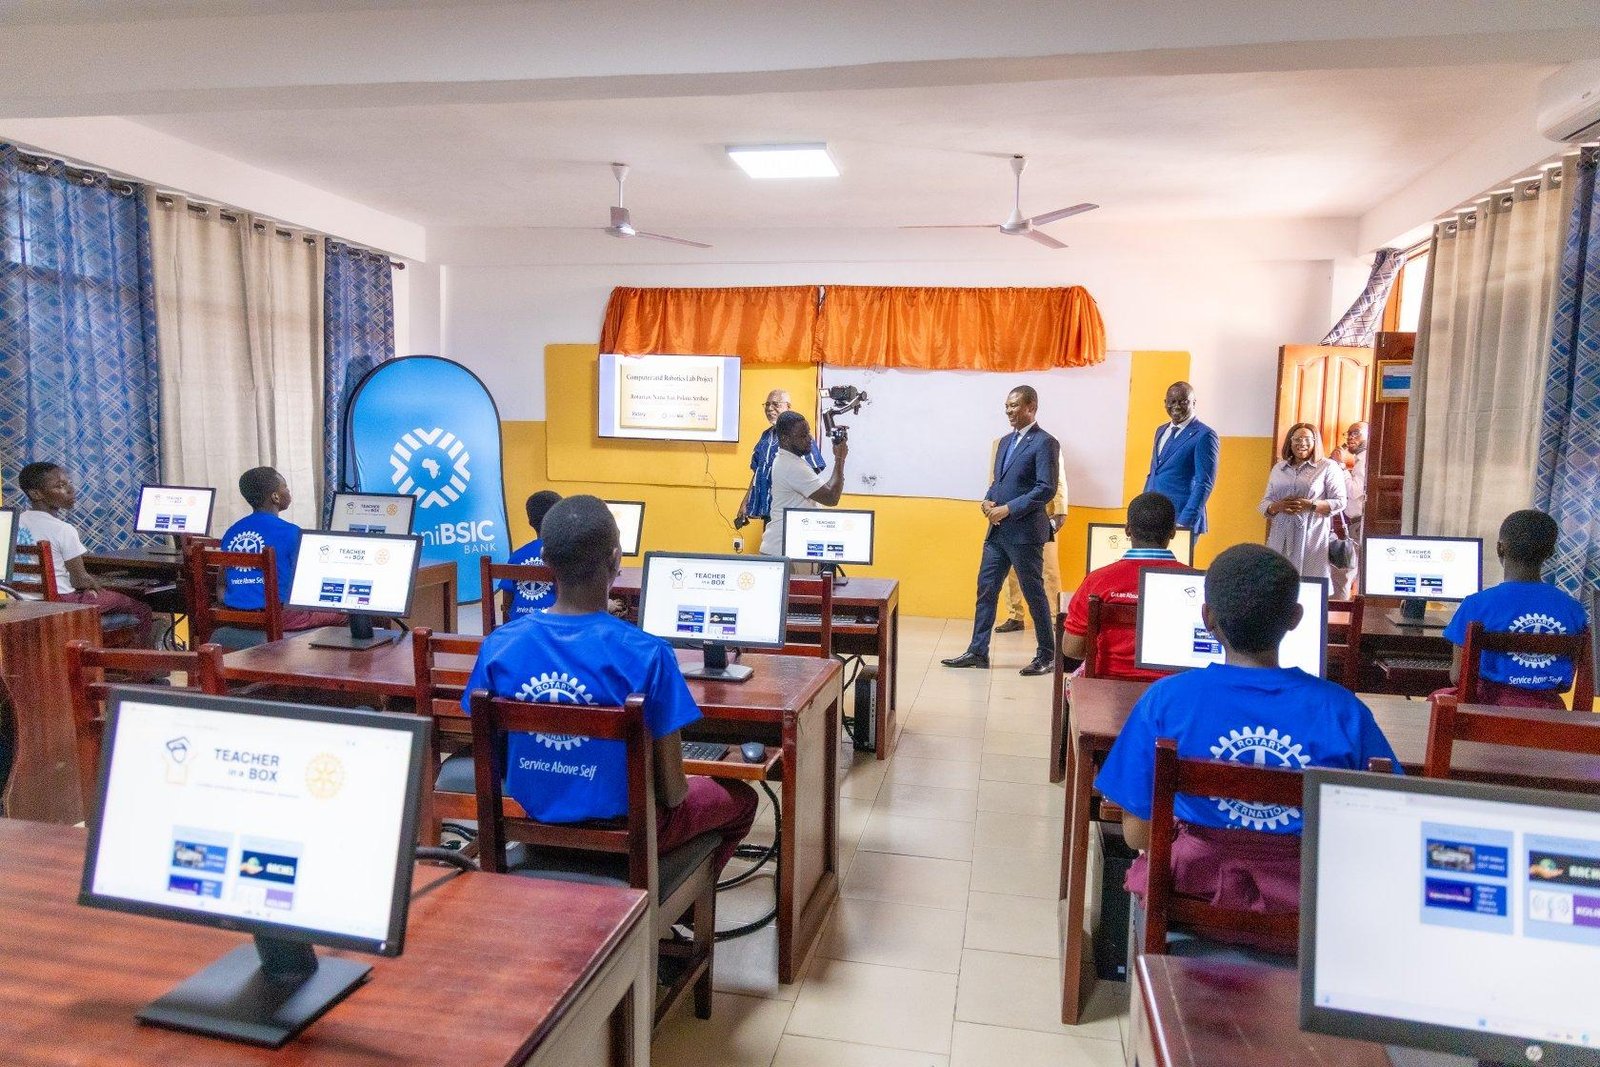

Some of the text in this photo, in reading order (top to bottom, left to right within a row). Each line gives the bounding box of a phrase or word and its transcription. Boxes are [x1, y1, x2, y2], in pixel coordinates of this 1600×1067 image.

[464, 542, 497, 554] BANK
[695, 572, 726, 580] TEACHER
[1508, 675, 1532, 685] Service
[536, 681, 572, 693] ROTARY
[1237, 737, 1285, 752] ROTARY
[214, 747, 280, 767] TEACHER
[248, 767, 278, 782] BOX
[519, 757, 598, 781] Service Above Self
